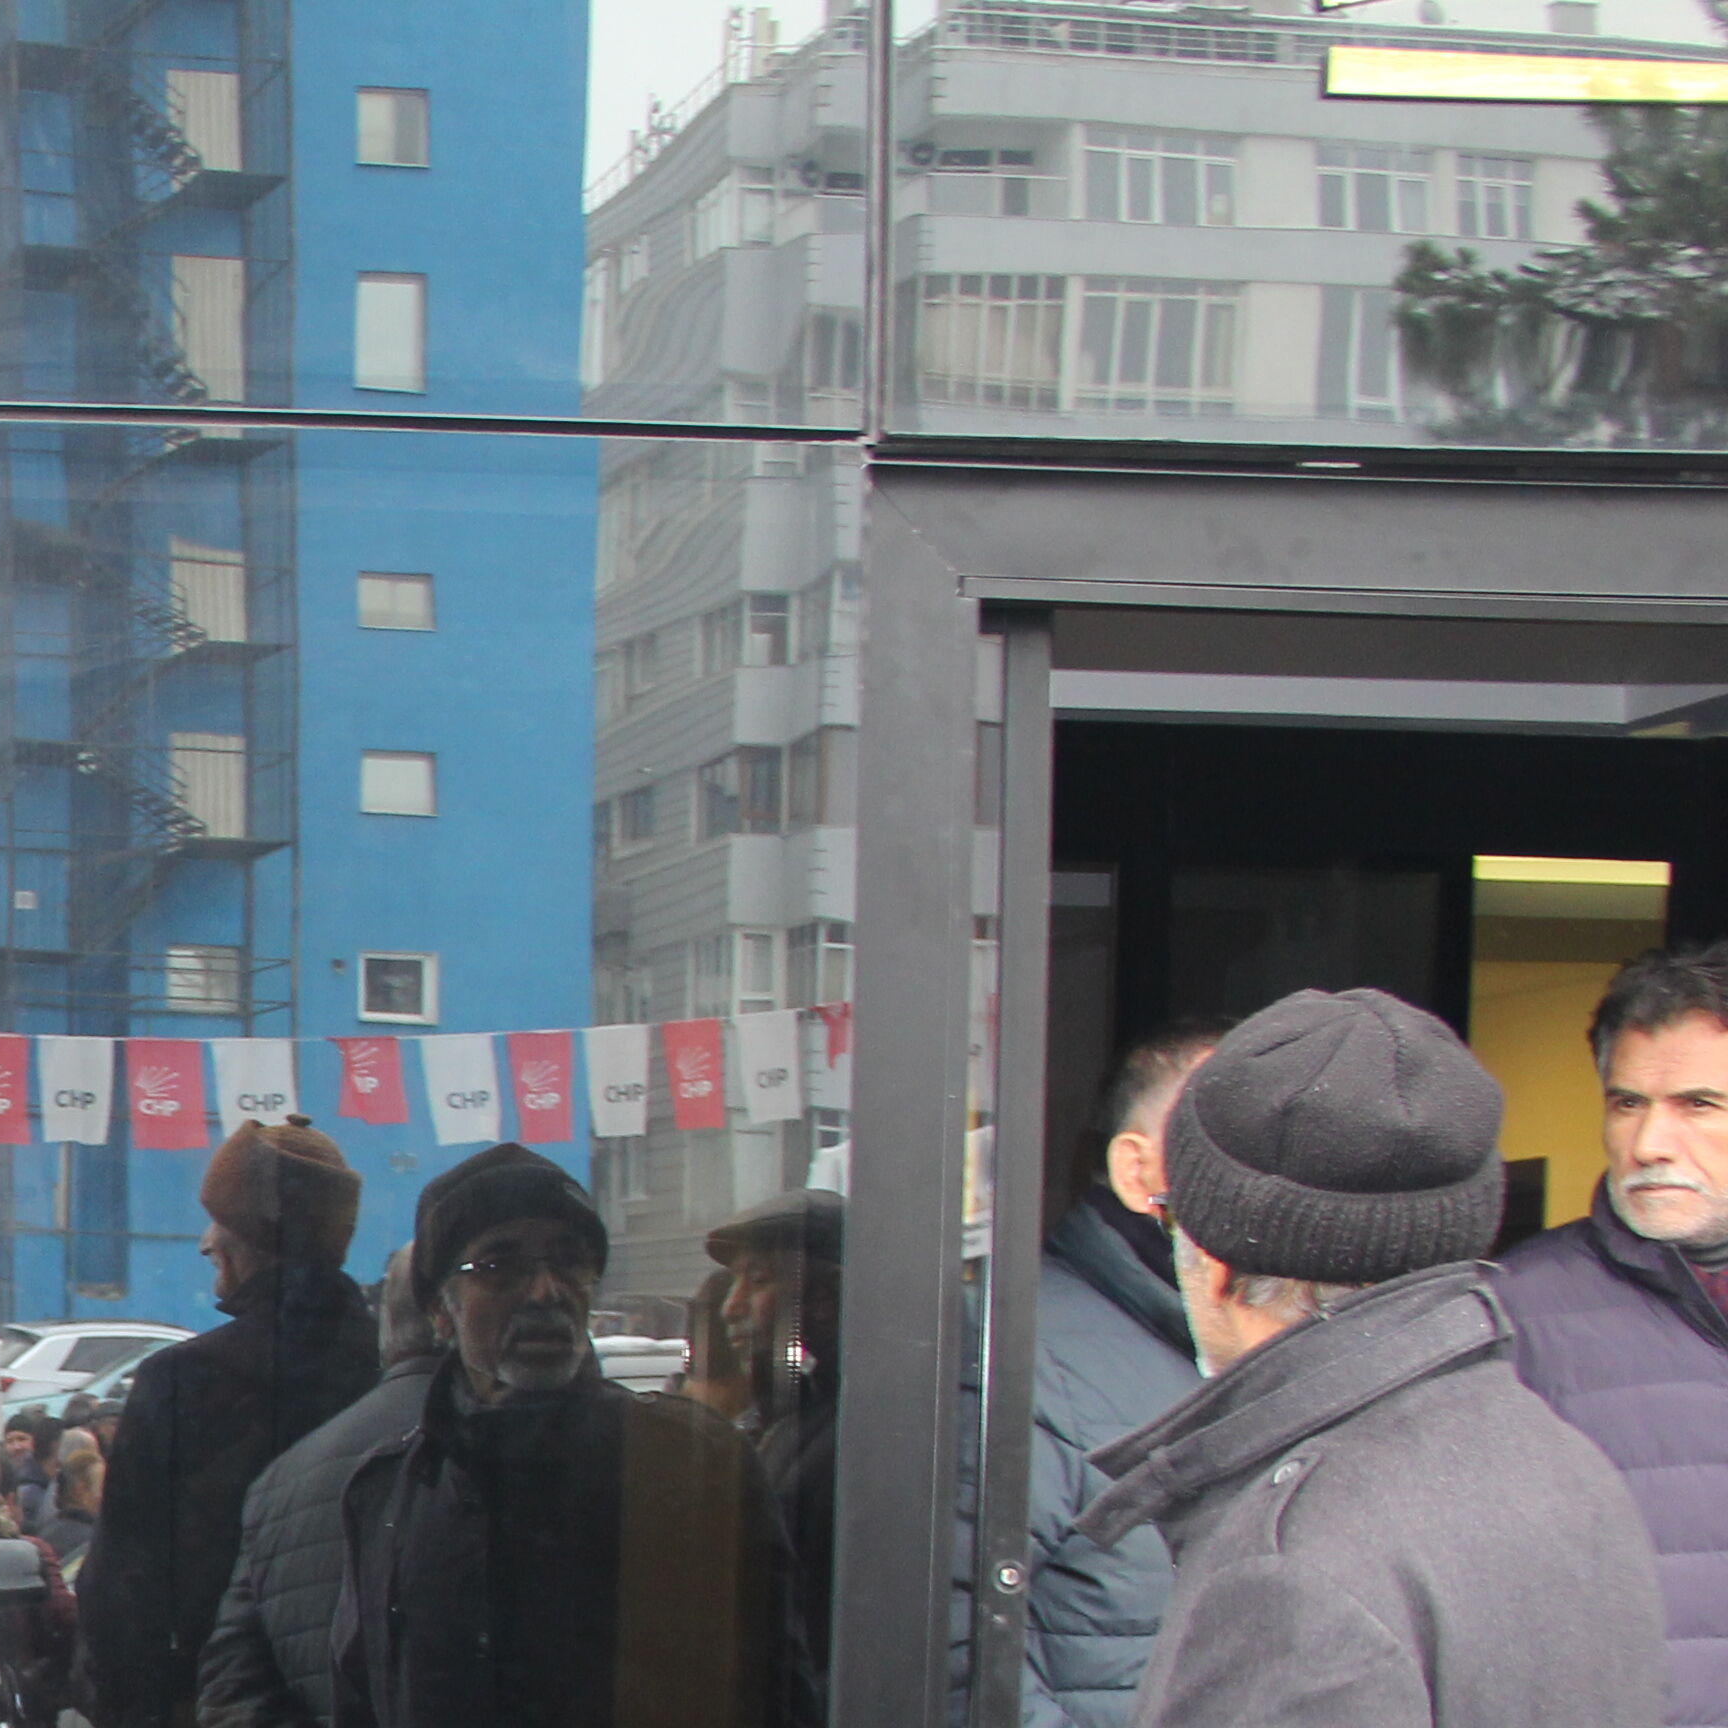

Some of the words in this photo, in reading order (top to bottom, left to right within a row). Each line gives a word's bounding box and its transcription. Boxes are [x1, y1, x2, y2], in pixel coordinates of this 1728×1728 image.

[755, 1066, 791, 1089] CHP
[55, 1089, 96, 1110] CHP
[446, 1089, 492, 1110] CHP
[603, 1083, 645, 1104] CHP
[679, 1079, 714, 1099] CHP
[138, 1098, 181, 1118] CHP
[238, 1092, 287, 1113] CHP
[523, 1091, 562, 1111] CHP
